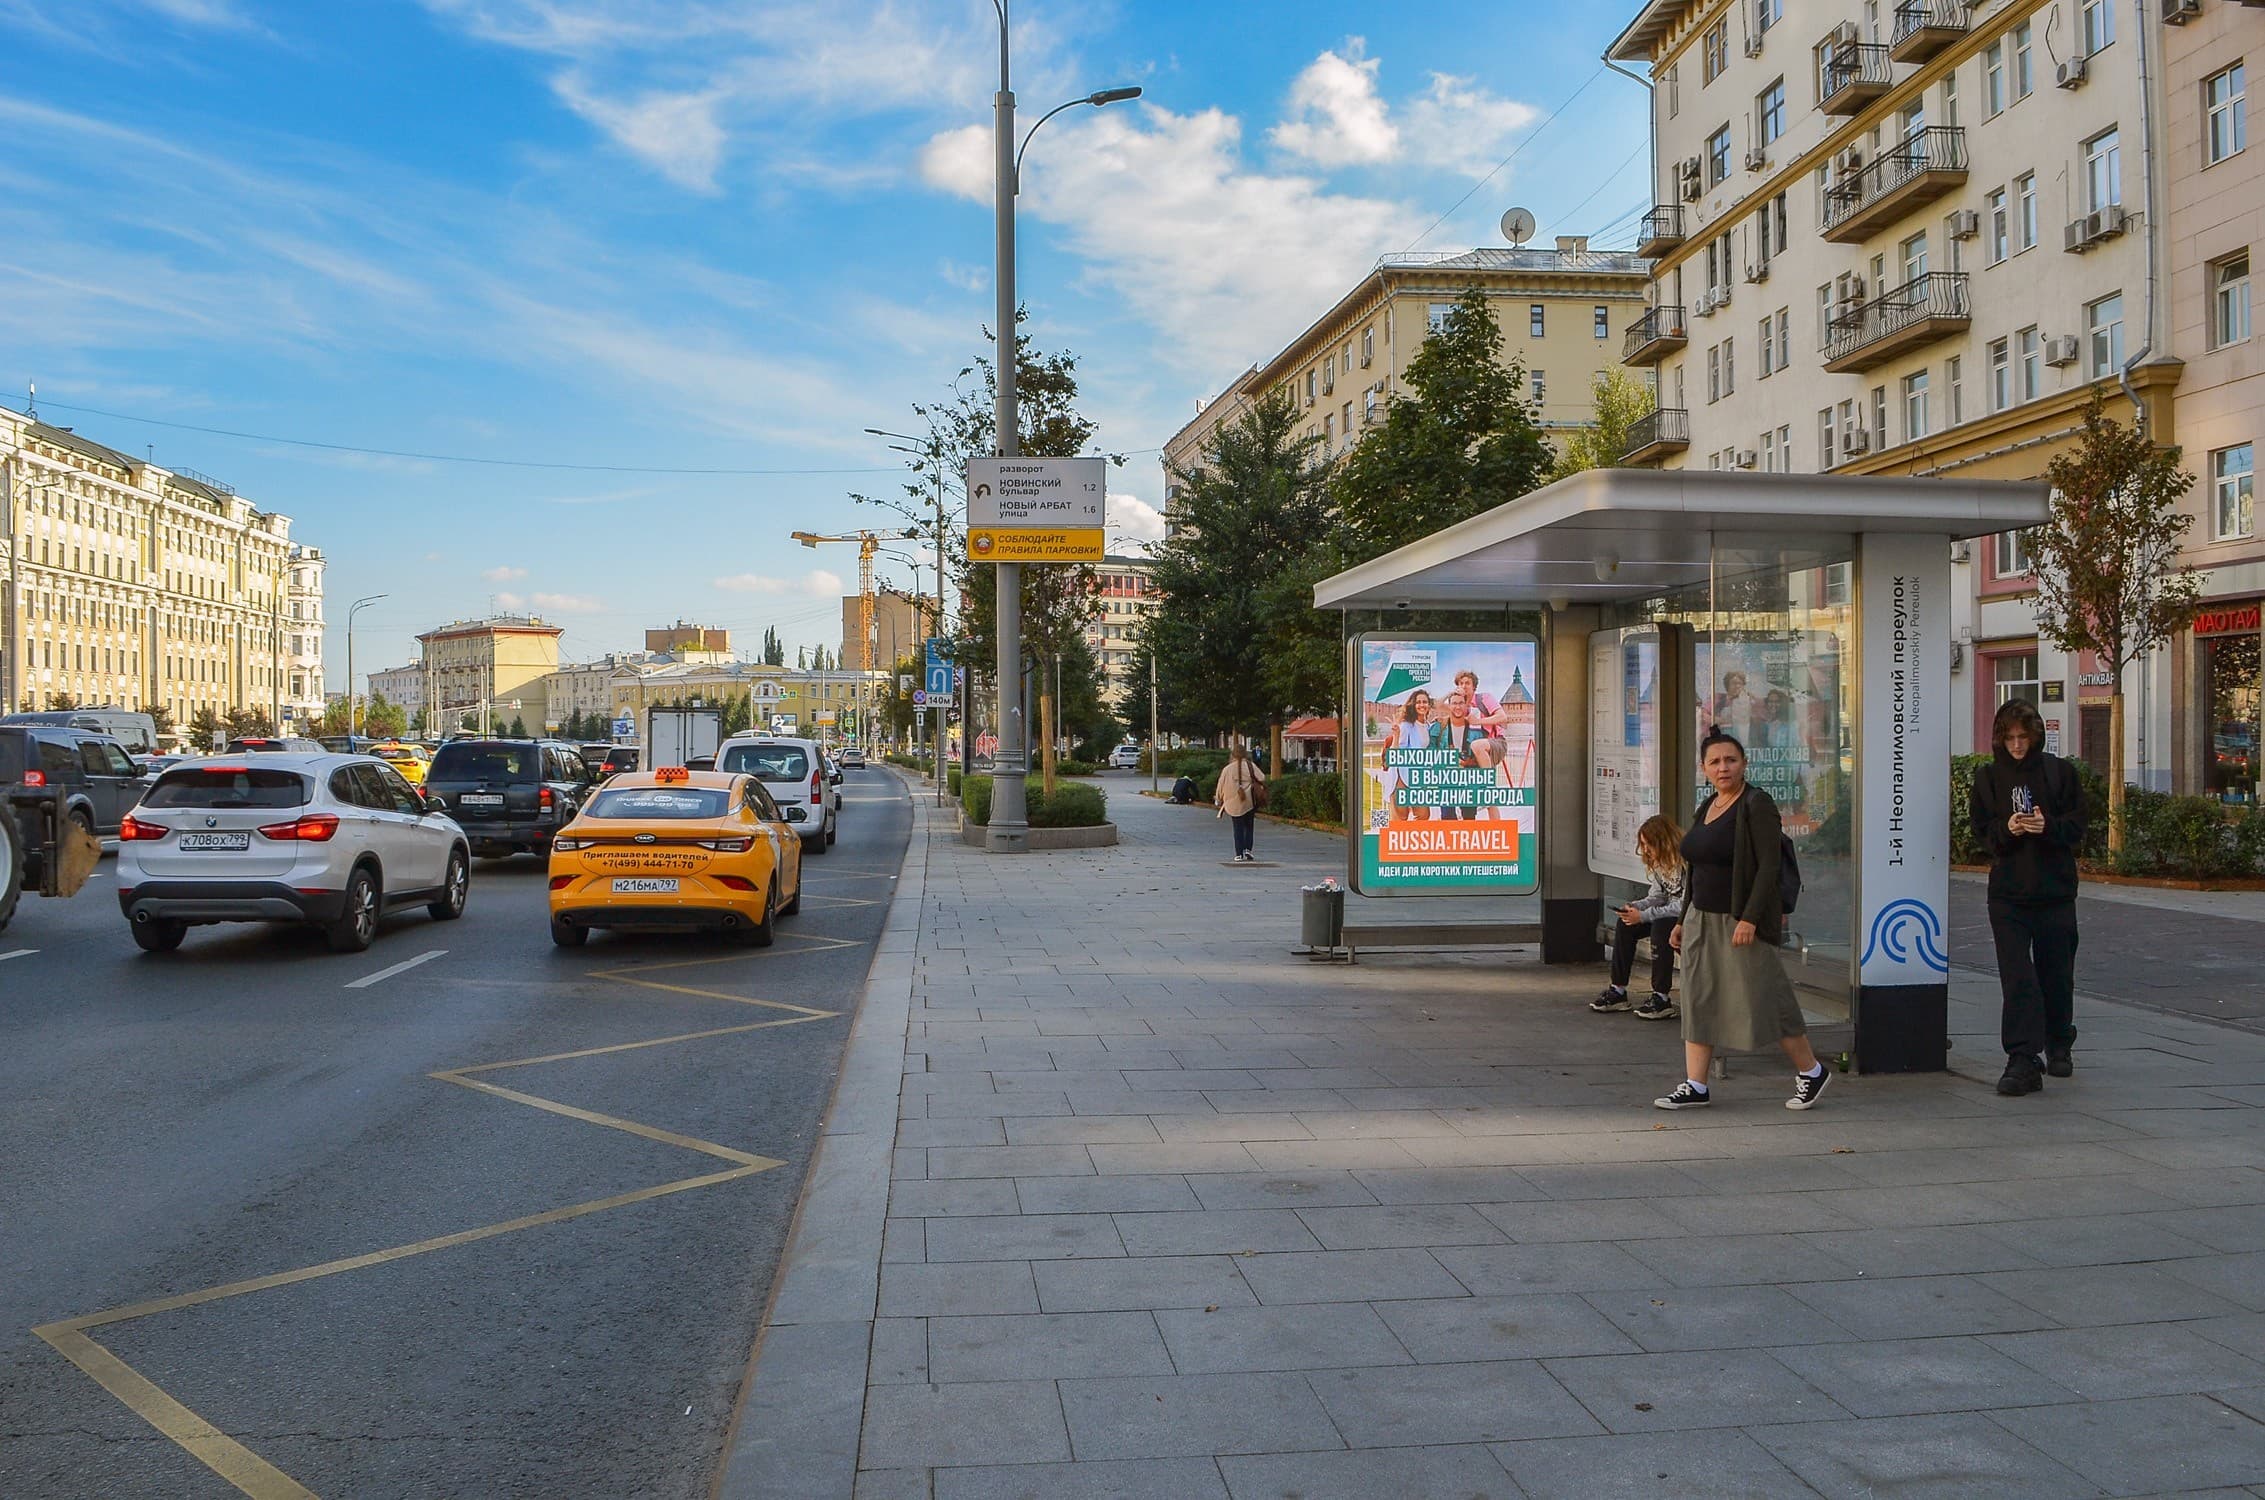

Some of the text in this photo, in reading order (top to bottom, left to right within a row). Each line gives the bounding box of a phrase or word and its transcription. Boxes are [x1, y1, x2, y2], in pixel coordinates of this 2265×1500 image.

[1000, 466, 1044, 474] разворот
[1000, 477, 1061, 487] НОВИНСКИЙ
[1000, 487, 1040, 496] бульвар
[1083, 484, 1096, 492] 1.2
[1000, 500, 1072, 510] НОВЫЙ АРБАТ
[1083, 506, 1096, 514] 1.6
[999, 511, 1028, 519] улица
[998, 534, 1067, 544] СОБЛЮДАЙТЕ
[998, 545, 1100, 555] ПРАВИЛА ПАРКОВКИ!
[1910, 576, 1920, 627] Pereulok
[1910, 631, 1921, 724] Neopalimovskiy
[1889, 576, 1907, 866] 1-й Неопалимовский переулок
[1388, 749, 1457, 766] ВЫХОДИТЕ
[1411, 769, 1495, 786] В ВЫХОДНЫЕ
[1398, 789, 1524, 806] В СОСЕДНИЕ ГОРОДА
[1388, 830, 1510, 851] RUSSIA.TRAVEL
[583, 851, 708, 861] Приглашаем водителей
[602, 859, 694, 869] +7(499) 444-71-70
[1378, 863, 1519, 878] ИДЕИ ДЛЯ КОРОТКИХ ПУТЕШЕСТВИЙ
